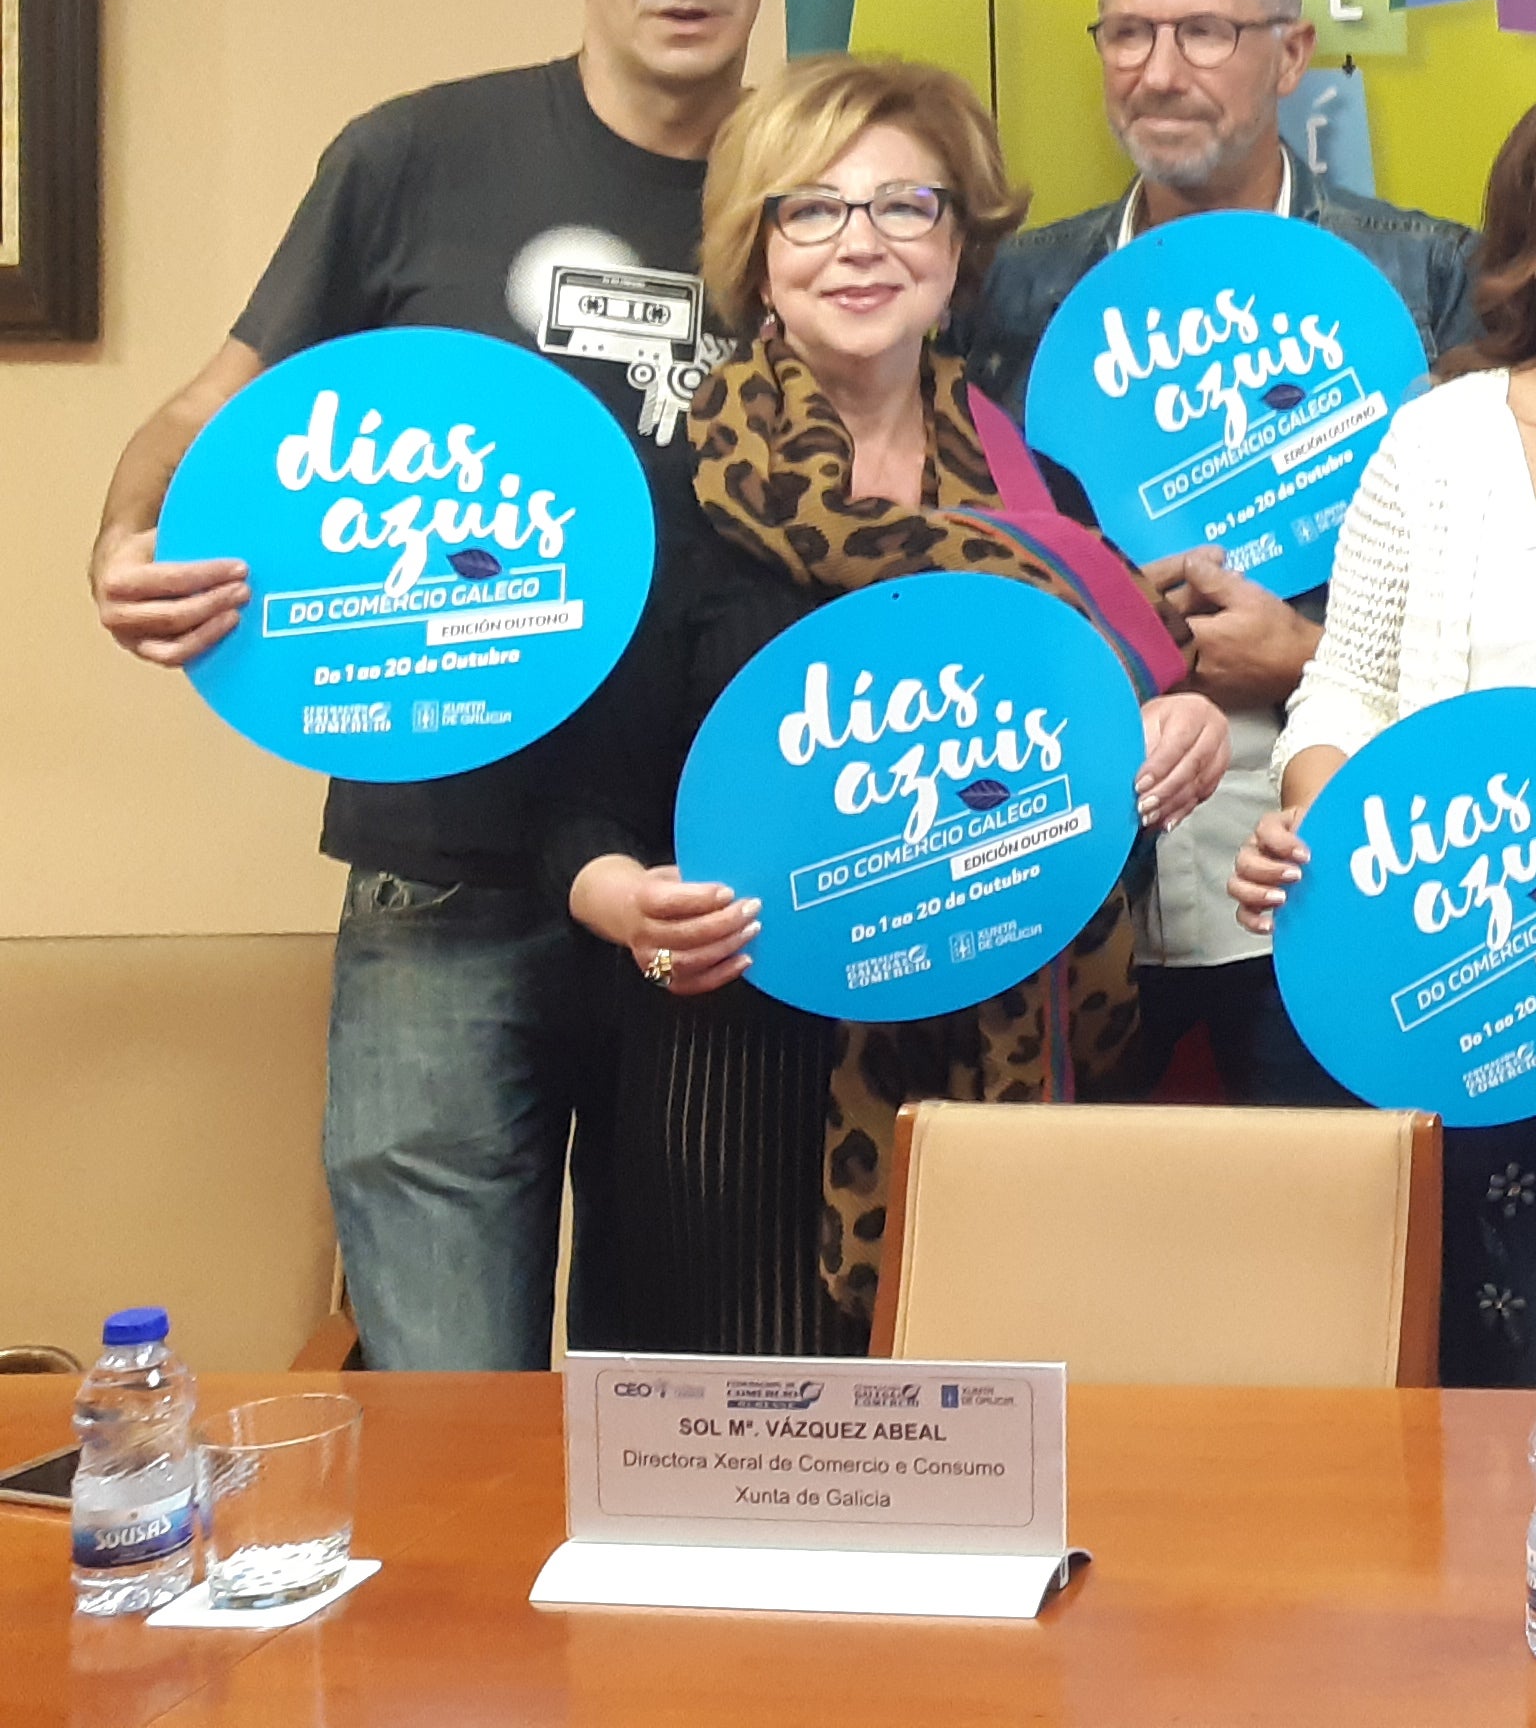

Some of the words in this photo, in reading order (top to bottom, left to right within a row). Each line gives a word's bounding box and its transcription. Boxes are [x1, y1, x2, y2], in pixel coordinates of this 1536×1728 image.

[1094, 288, 1258, 397] días
[1155, 313, 1343, 448] azuis
[276, 390, 495, 492] días
[1163, 474, 1189, 500] DO
[1278, 388, 1342, 435] GALEGO
[321, 474, 576, 599] azuis
[290, 601, 323, 623] DO
[452, 578, 540, 606] GALEGO
[505, 613, 568, 629] OUTONO
[778, 662, 985, 766] días
[834, 700, 1068, 843] azuis
[818, 866, 849, 891] DO
[854, 825, 963, 878] COMERCIO
[968, 794, 1047, 838] GALEGO
[964, 840, 1018, 871] EDICIÓN
[1021, 818, 1079, 849] OUTONO
[1350, 773, 1530, 896] días
[851, 925, 875, 942] Do
[880, 916, 887, 932] 1
[892, 913, 913, 928] ao
[918, 898, 941, 919] 20
[945, 891, 966, 910] de
[969, 865, 1041, 900] Outubro
[1417, 981, 1445, 1009] DO
[1460, 1033, 1482, 1052] Do
[1484, 1023, 1492, 1037] 1
[1495, 1015, 1514, 1032] ao
[1515, 997, 1536, 1020] 20
[623, 1450, 706, 1469] Directora
[714, 1453, 762, 1470] Xeral
[770, 1455, 792, 1471] de
[800, 1455, 889, 1474] Comercio
[897, 1461, 906, 1474] e
[914, 1457, 1005, 1476] Consumo
[679, 1418, 721, 1436] SOL
[766, 1416, 867, 1440] VÁZQUEZ
[873, 1423, 947, 1441] ABEAL
[735, 1487, 789, 1505] Xunta
[797, 1488, 820, 1506] de
[827, 1489, 891, 1508] Galicia
